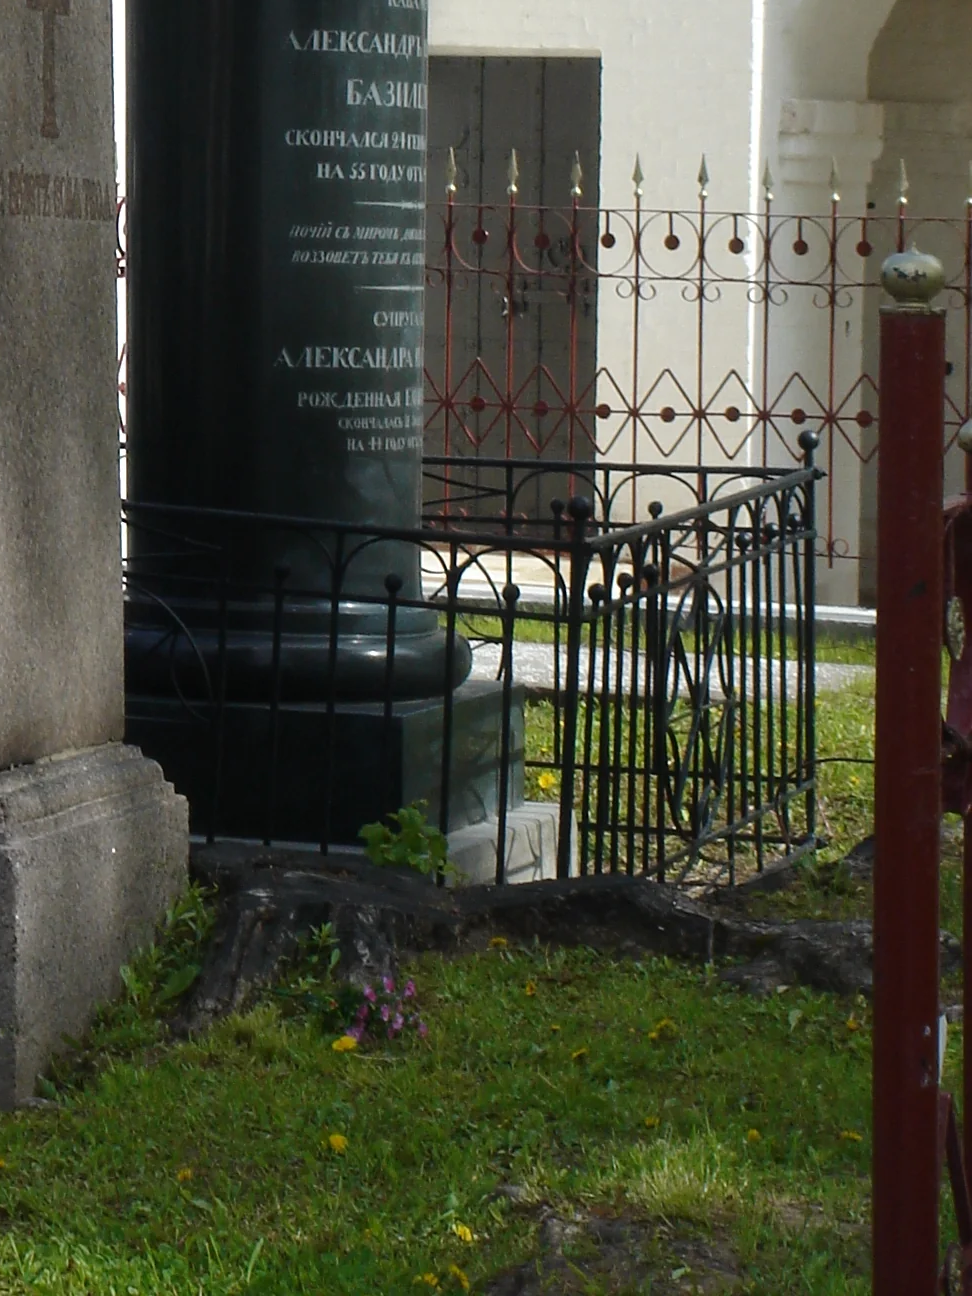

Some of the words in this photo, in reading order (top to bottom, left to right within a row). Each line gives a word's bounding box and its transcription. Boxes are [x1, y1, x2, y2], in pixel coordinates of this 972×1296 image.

[284, 129, 388, 148] СКОНЧАЛСЯ
[316, 162, 345, 180] НА
[349, 162, 367, 181] 55
[370, 164, 405, 184] ГОДУ
[291, 250, 369, 264] ВОЗЗОВЕТЪ
[273, 346, 413, 371] АЛЕКСАНДРА
[297, 391, 401, 409] РОЖДЕННАЯ
[347, 438, 364, 452] НА
